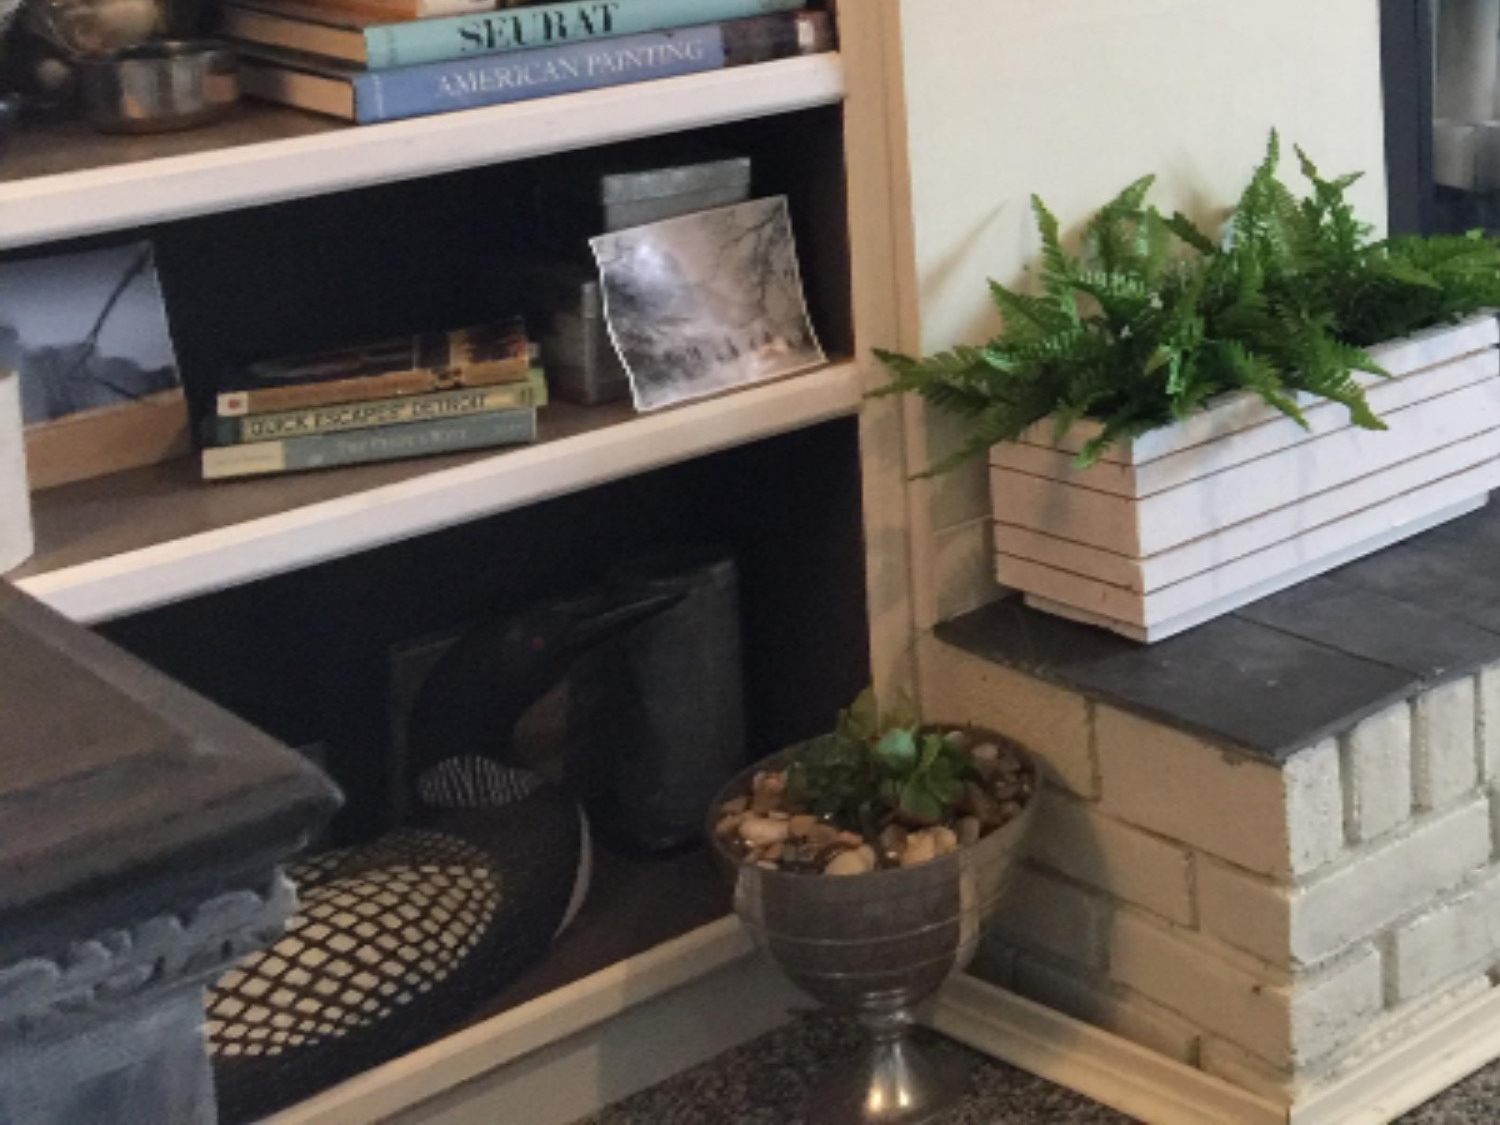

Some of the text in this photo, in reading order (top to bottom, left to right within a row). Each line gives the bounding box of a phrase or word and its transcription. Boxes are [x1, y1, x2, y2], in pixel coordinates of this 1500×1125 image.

[457, 2, 619, 51] SEURAT
[436, 38, 704, 98] AMERICAN PAINTING
[250, 414, 308, 437] QUICK
[411, 393, 487, 418] DETROIT
